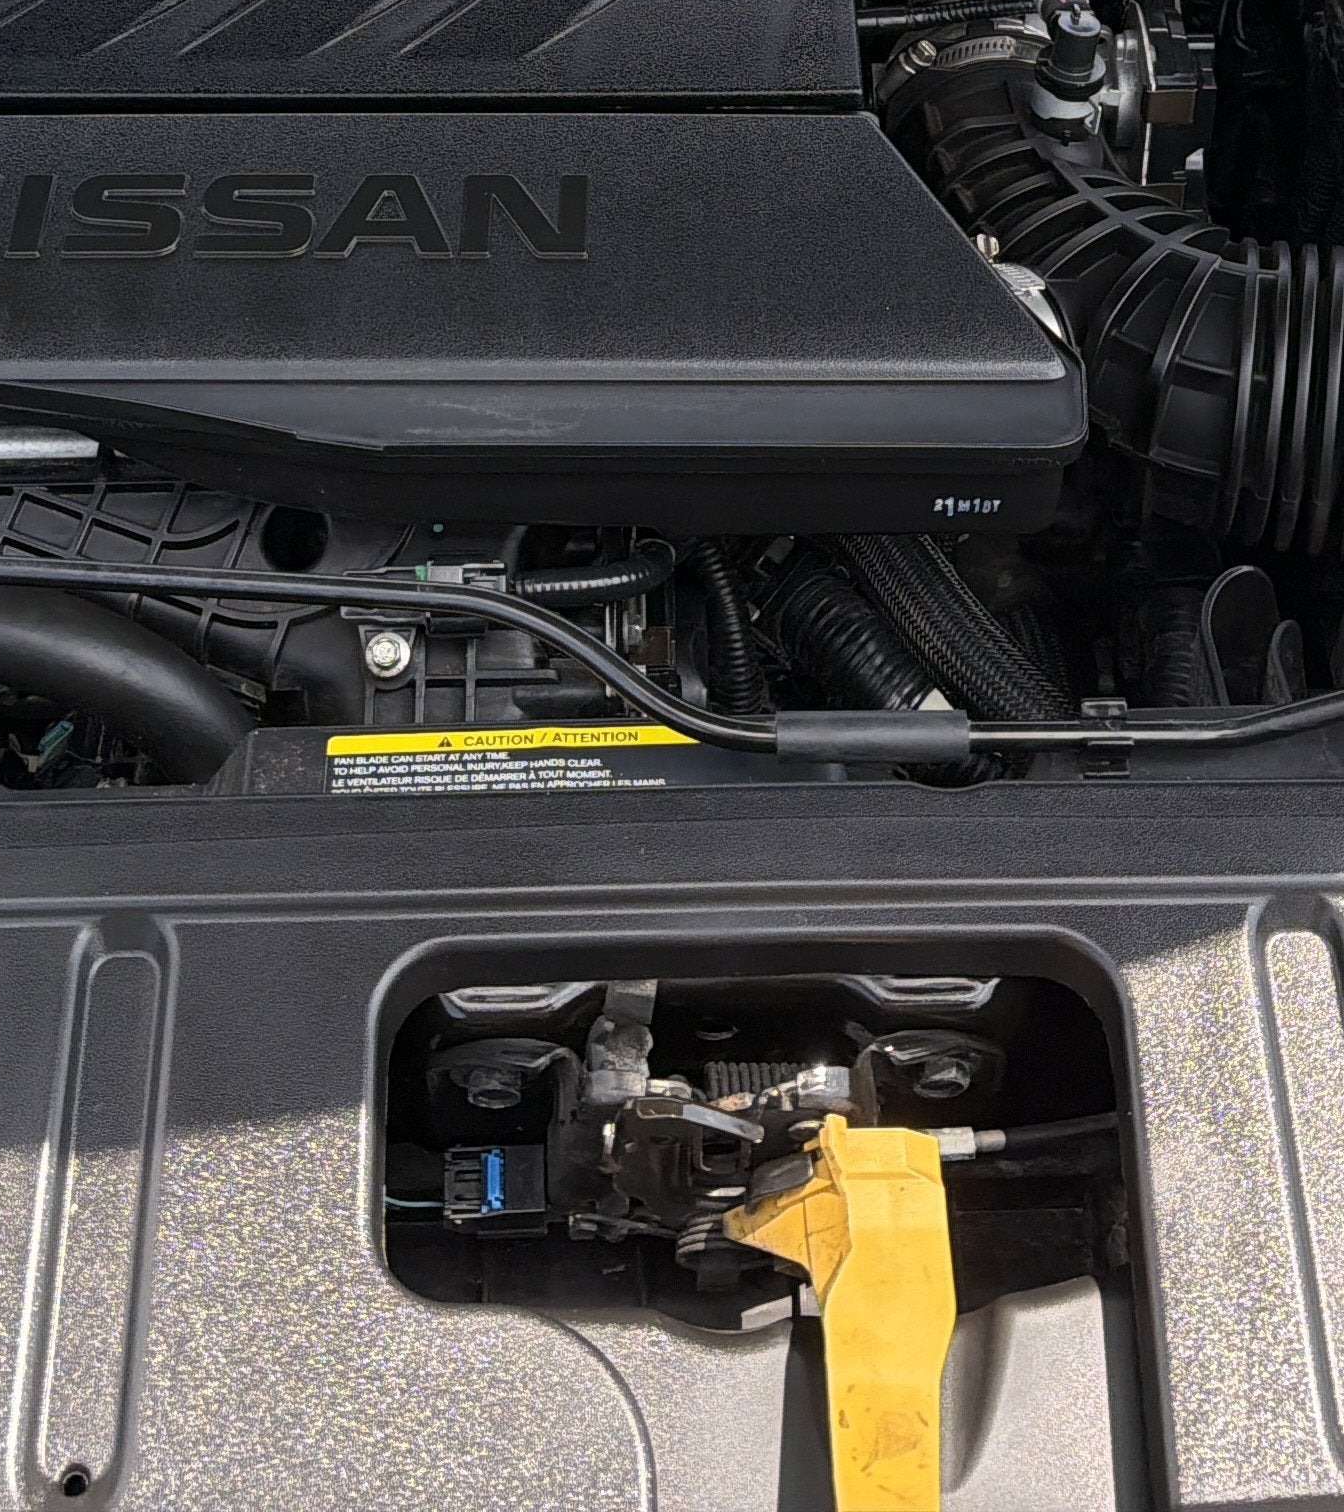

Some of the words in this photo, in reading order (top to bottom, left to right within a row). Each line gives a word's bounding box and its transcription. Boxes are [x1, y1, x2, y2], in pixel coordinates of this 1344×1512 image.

[463, 733, 535, 747] CAUTION
[552, 730, 640, 744] ATTENTION
[333, 767, 347, 775] TO
[349, 766, 376, 775] HELP
[377, 765, 409, 774] AVOID
[411, 763, 466, 773] PERSONAL
[530, 759, 565, 768] HANDS
[567, 758, 603, 767] CLEAR.
[334, 757, 354, 765] FAN
[356, 755, 389, 764] BLADE
[391, 755, 413, 764] CAN
[415, 753, 446, 762] START
[448, 753, 460, 761] AT
[462, 752, 484, 761] ANY
[485, 751, 511, 760] TIME.
[332, 778, 345, 787] LE
[347, 776, 413, 786] VENTILATEUR
[414, 774, 452, 784] RISQUE
[454, 773, 469, 782] DE
[471, 772, 526, 782] DÉMARRER
[528, 770, 536, 780] À
[538, 769, 565, 779] TOUT
[566, 769, 613, 779] MOMENT.
